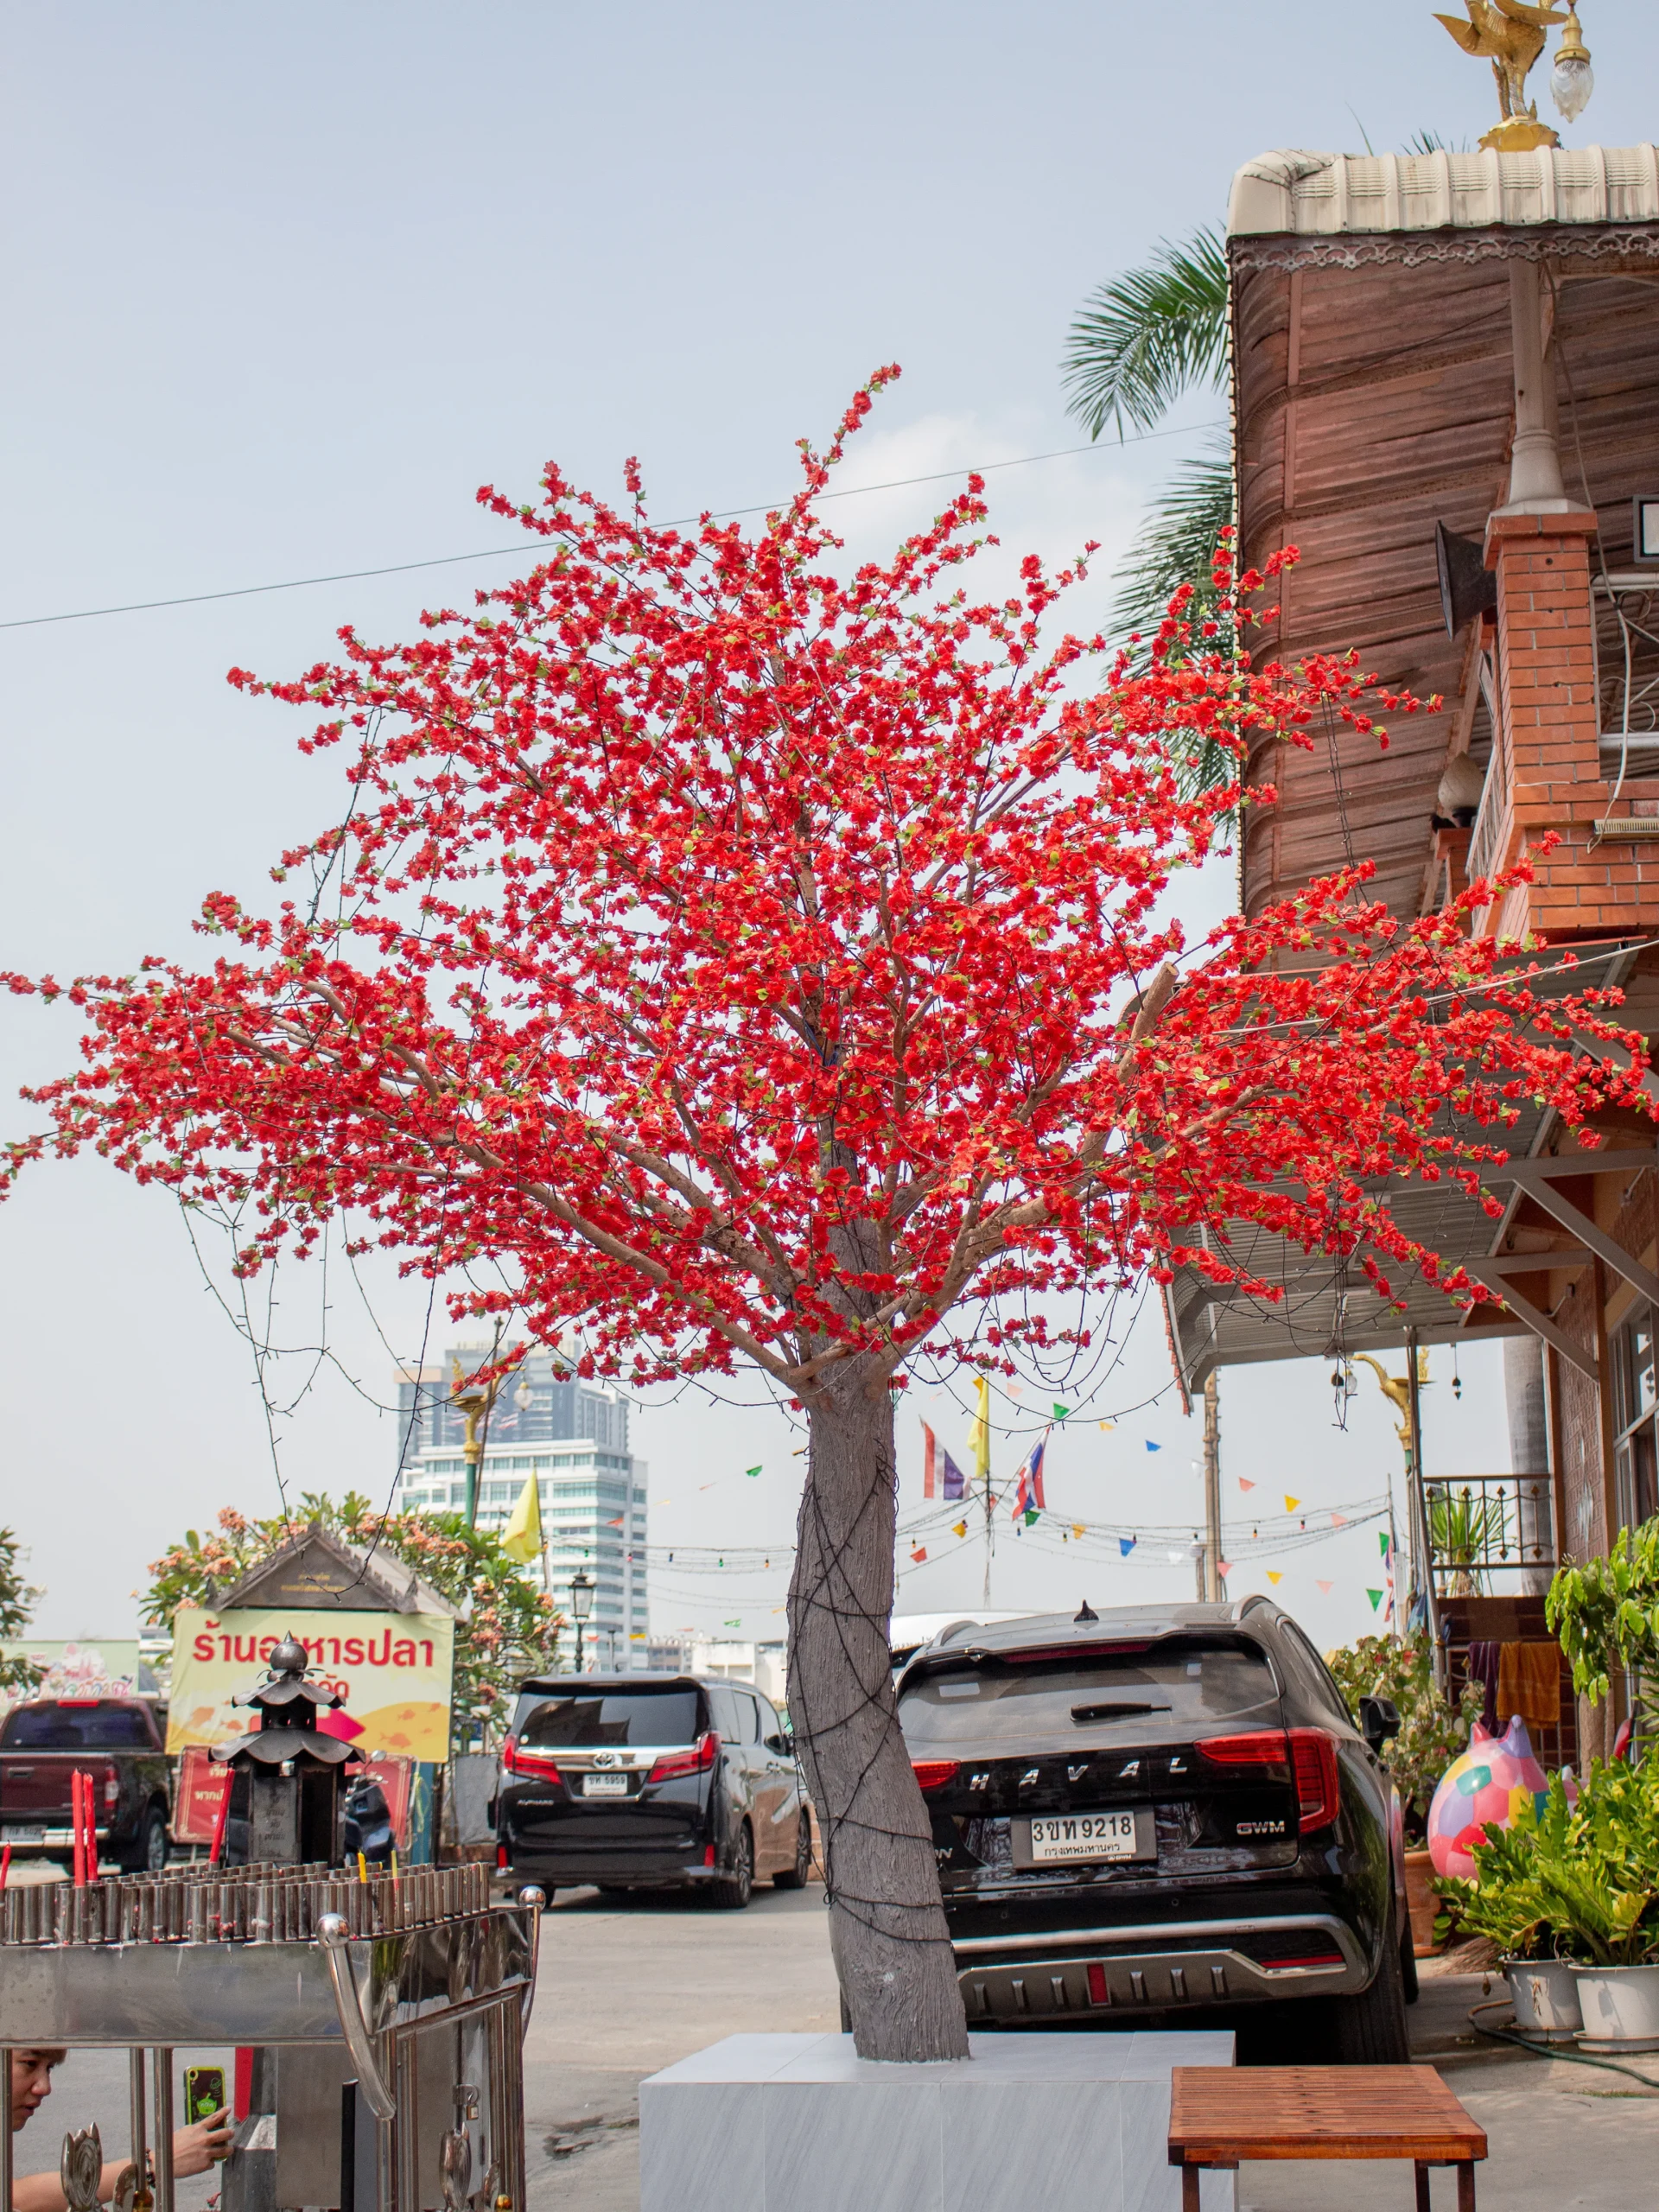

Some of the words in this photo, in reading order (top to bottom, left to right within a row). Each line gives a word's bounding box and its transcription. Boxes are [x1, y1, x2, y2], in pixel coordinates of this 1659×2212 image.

[193, 1619, 433, 1667] ร้านอหารปลา
[969, 1758, 1187, 1790] HAVAL
[1033, 1819, 1077, 1842] 3ขท
[1081, 1815, 1132, 1840] 9218
[1236, 1820, 1285, 1835] GWM
[1044, 1842, 1121, 1859] กรุงเทพมหานคร
